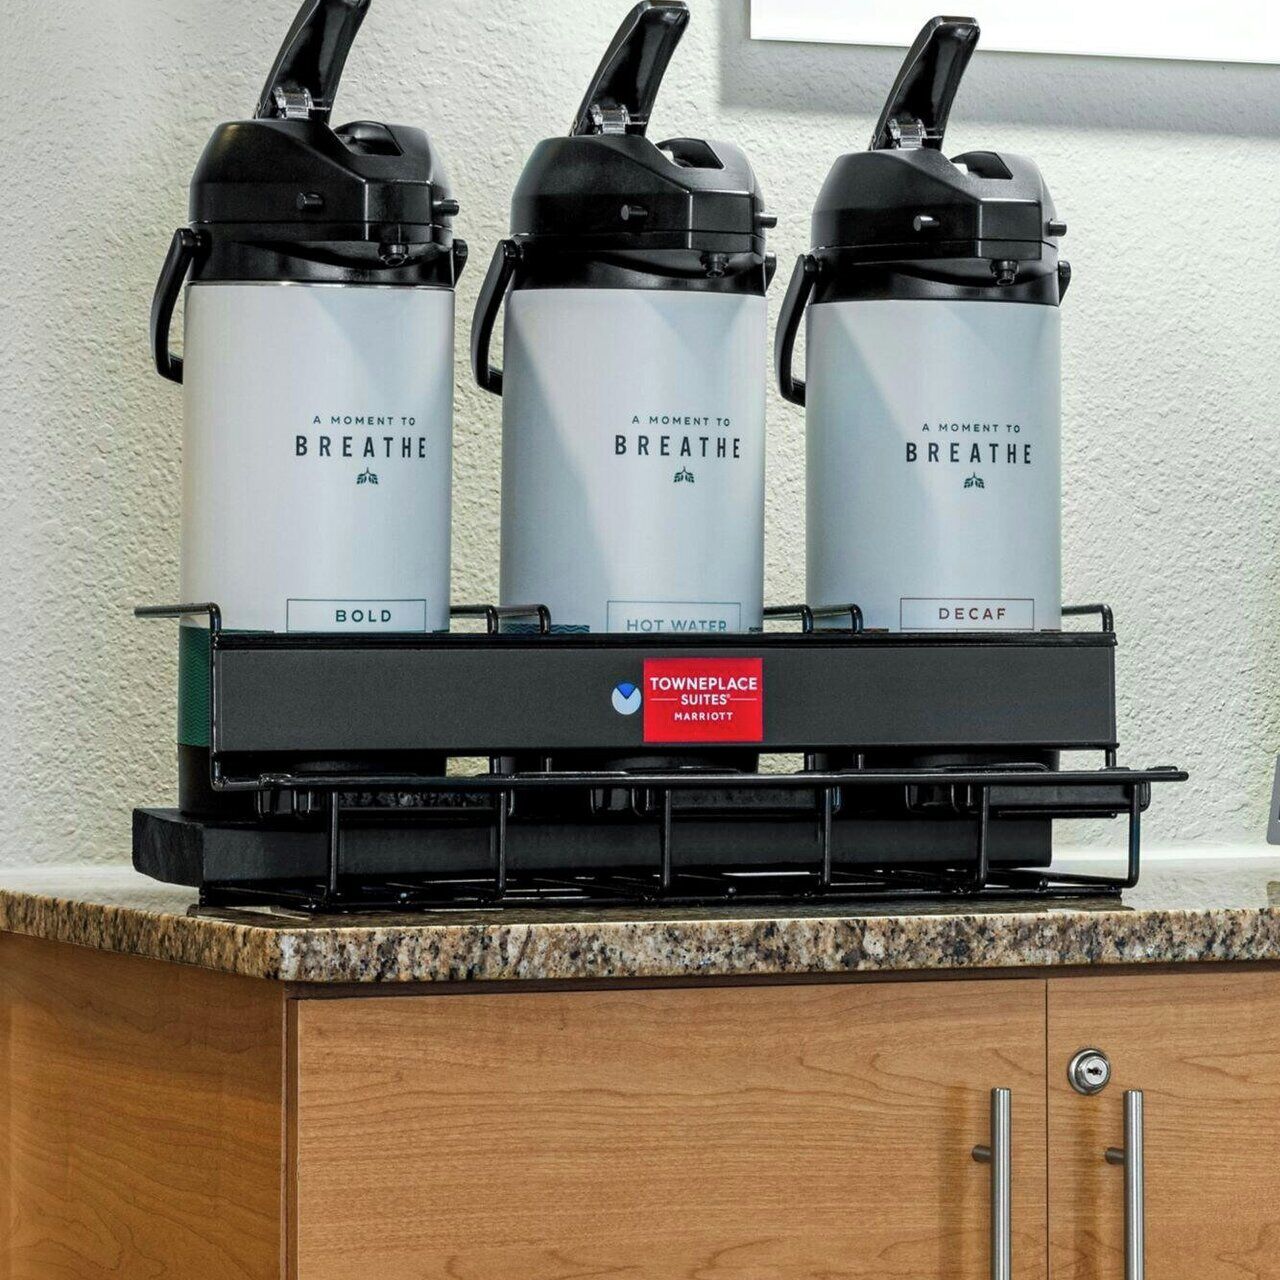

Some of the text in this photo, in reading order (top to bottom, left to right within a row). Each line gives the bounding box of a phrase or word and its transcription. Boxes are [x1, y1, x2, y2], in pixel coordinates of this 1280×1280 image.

[312, 415, 416, 426] A MOMENT TO
[631, 415, 731, 427] A MOMENT TO
[921, 423, 1021, 434] A MOMENT TO
[295, 435, 426, 459] BREATHE
[614, 434, 741, 459] BREATHE
[905, 442, 1032, 465] BREATHE
[335, 609, 392, 623] BOLD
[938, 607, 1006, 621] DECAF
[626, 619, 727, 632] HOT WATER
[648, 676, 758, 691] TOWNEPLACE
[674, 711, 734, 721] MARRIOTT
